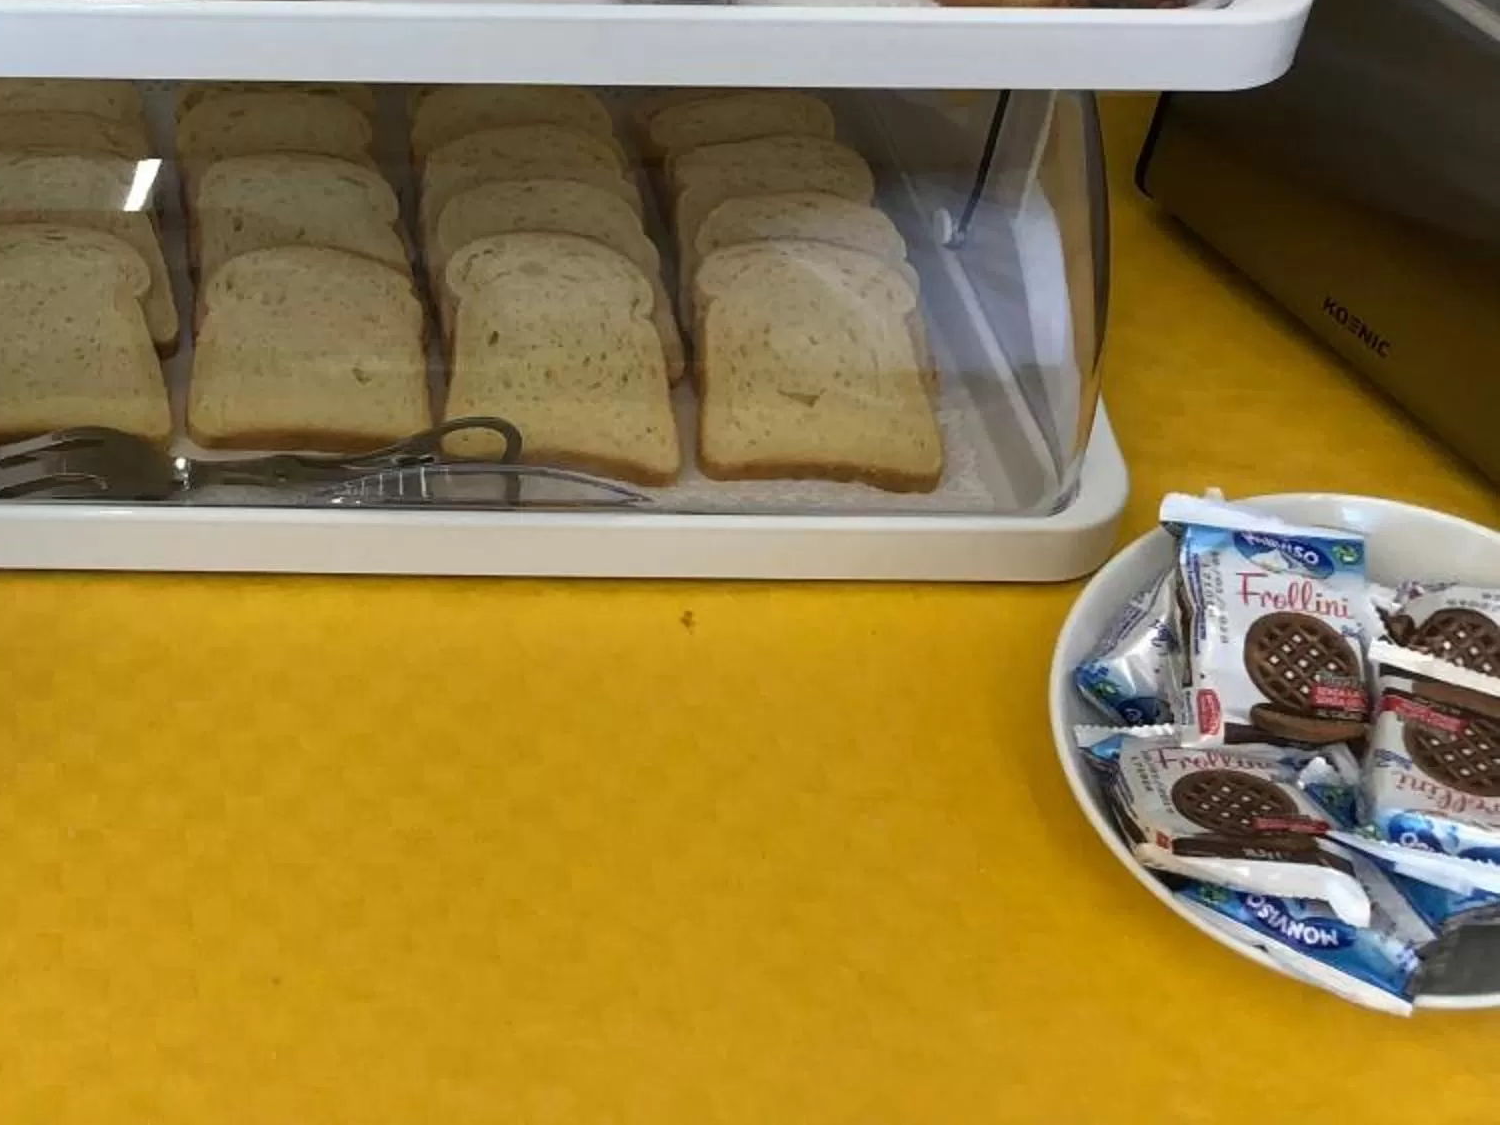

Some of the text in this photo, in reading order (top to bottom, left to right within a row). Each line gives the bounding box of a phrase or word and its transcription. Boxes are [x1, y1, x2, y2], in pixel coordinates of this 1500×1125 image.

[1323, 297, 1391, 358] KOENIC
[1237, 572, 1352, 619] Frollini
[1246, 893, 1339, 946] MONVISO
